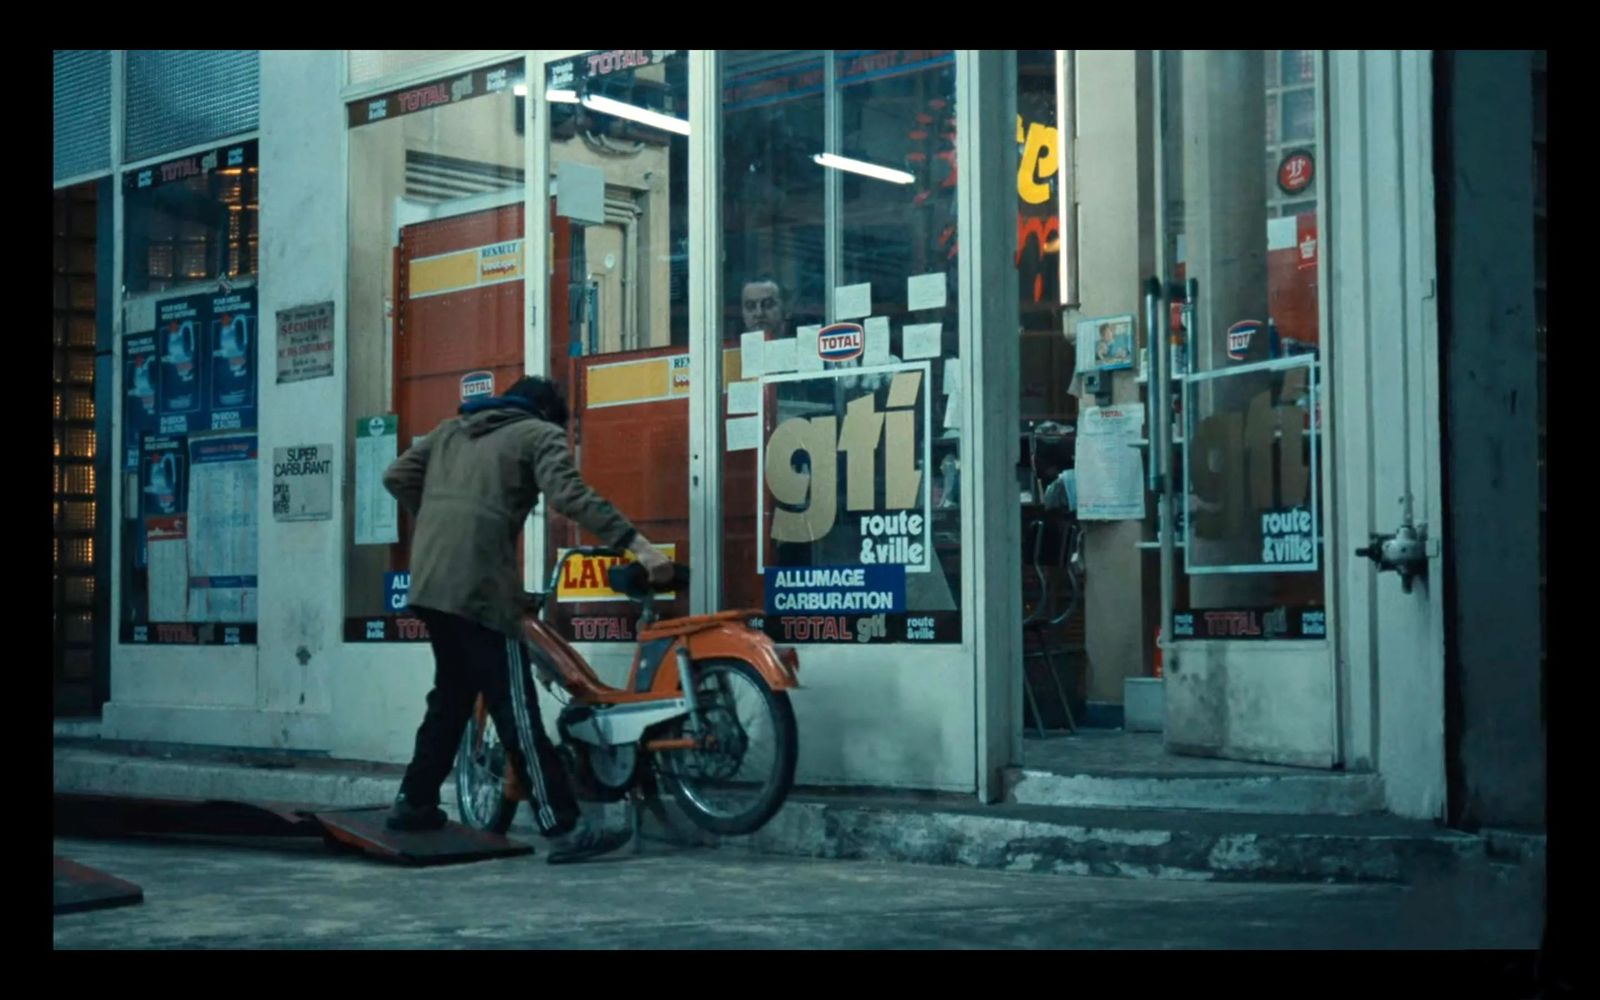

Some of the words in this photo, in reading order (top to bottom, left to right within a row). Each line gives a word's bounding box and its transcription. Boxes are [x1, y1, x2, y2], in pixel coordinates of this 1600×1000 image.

[587, 49, 649, 77] TOTAL
[397, 81, 449, 112] TOTAL
[481, 242, 517, 258] RENAULT
[821, 334, 860, 350] TOTAL
[464, 381, 492, 394] TOTAL
[287, 446, 318, 462] SUPER
[765, 371, 922, 542] gti
[274, 460, 331, 477] CARBURANT
[860, 510, 924, 536] route
[1262, 509, 1311, 534] route
[860, 537, 924, 564] &ville
[1262, 535, 1311, 563] &ville
[775, 569, 865, 588] ALLUMAGE
[774, 591, 893, 611] CARBURATION
[396, 618, 428, 640] TOT
[571, 617, 633, 641] TOTAL
[780, 616, 853, 641] TOTAL
[857, 613, 887, 643] gti
[907, 616, 935, 627] route
[1204, 611, 1261, 635] TOTAL
